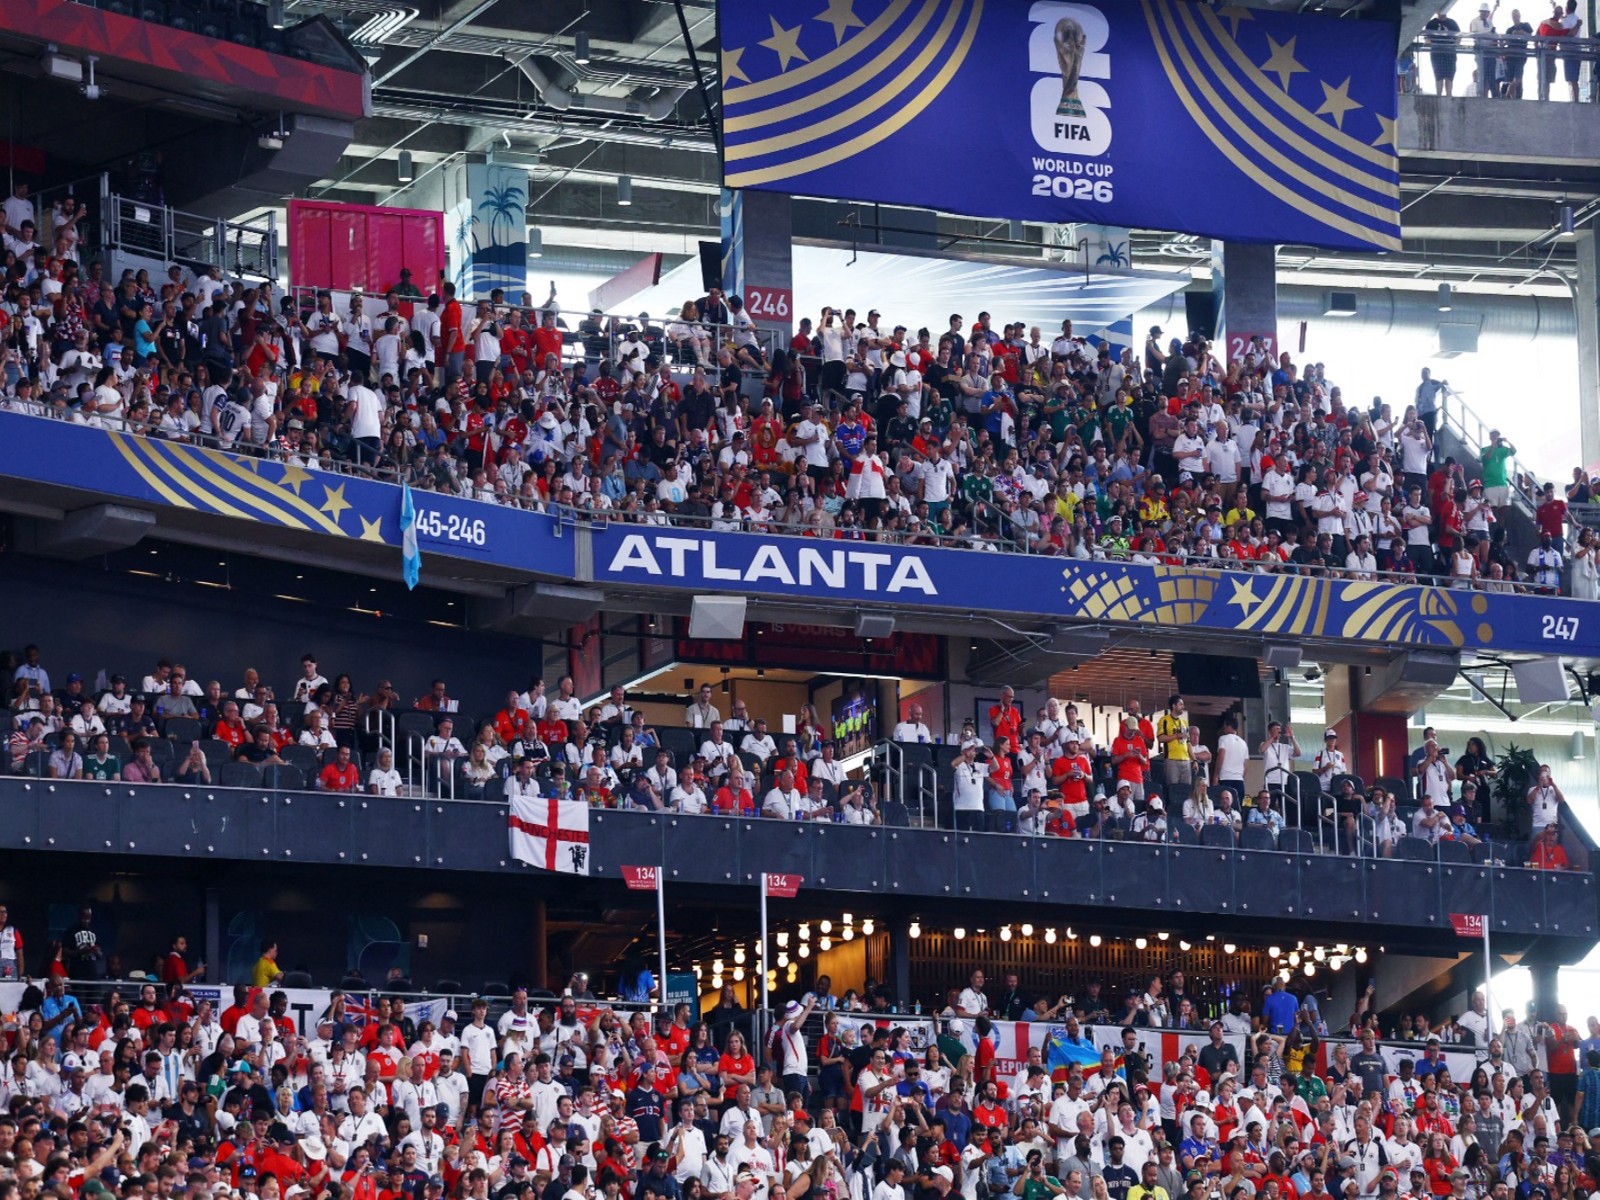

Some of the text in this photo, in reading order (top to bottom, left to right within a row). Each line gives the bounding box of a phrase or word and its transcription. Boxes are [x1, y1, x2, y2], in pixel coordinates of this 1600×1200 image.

[1054, 122, 1091, 141] FIFA
[1032, 157, 1113, 177] WORLD CUP
[1032, 174, 1113, 203] 2026
[750, 291, 788, 316] 246
[414, 508, 486, 546] 45-246
[608, 534, 938, 595] ATLANTA
[771, 622, 785, 632] IS
[1541, 614, 1580, 641] 247
[636, 867, 655, 880] 134
[767, 875, 787, 887] 134
[1464, 914, 1482, 927] 134
[291, 1003, 314, 1037] T
